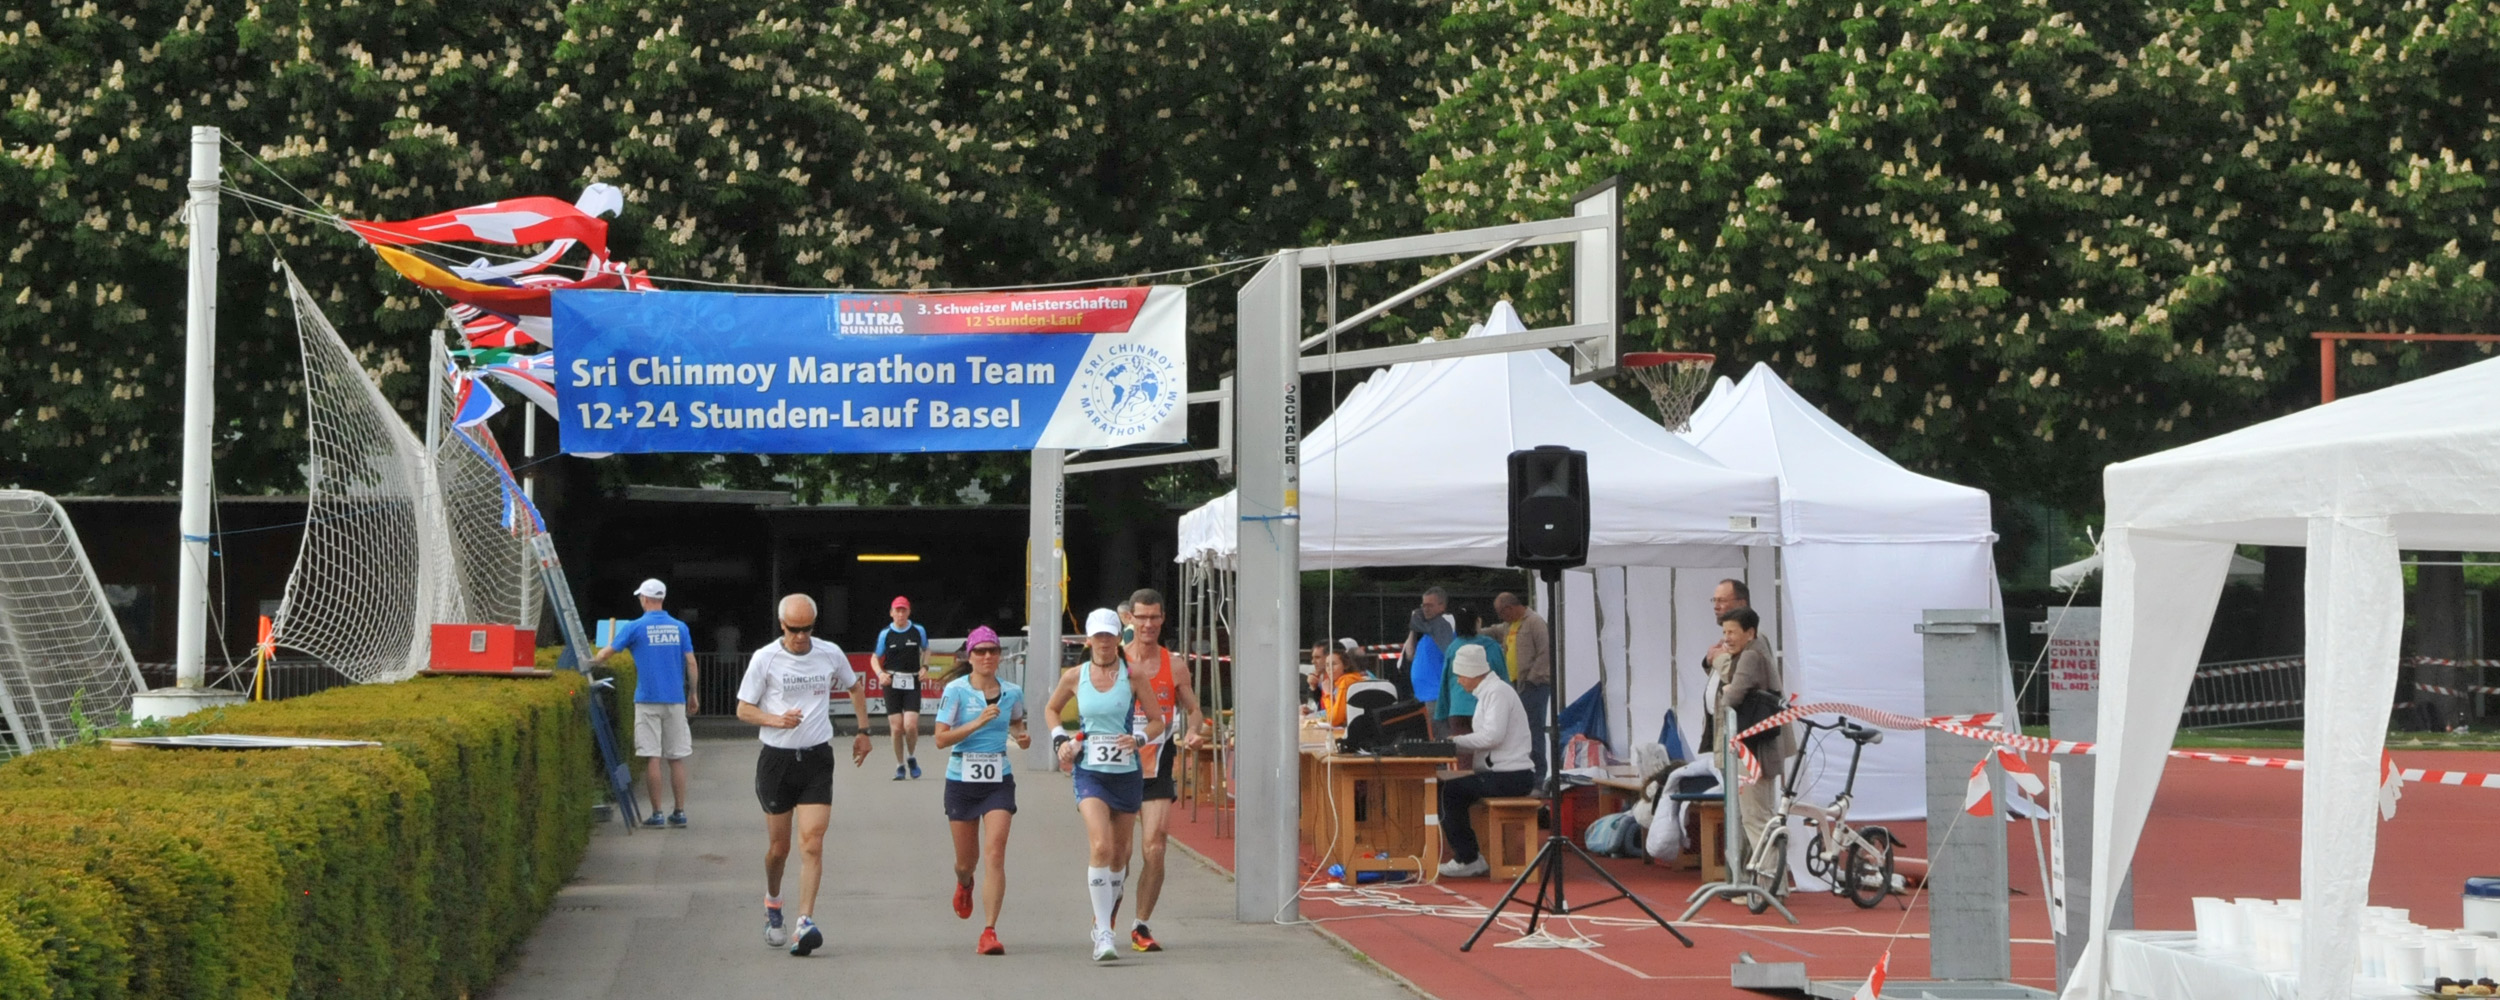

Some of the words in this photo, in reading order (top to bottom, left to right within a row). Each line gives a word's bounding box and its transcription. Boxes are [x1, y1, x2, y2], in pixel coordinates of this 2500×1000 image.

[917, 303, 931, 315] 3.
[934, 302, 1006, 315] Schweizer
[1011, 296, 1128, 311] Meisterschaften
[840, 313, 904, 325] ULTRA
[966, 316, 982, 327] 12
[987, 313, 1083, 326] Stunden-Lauf
[841, 326, 904, 334] RUNNING
[1085, 354, 1104, 376] SRI
[1109, 343, 1173, 371] CHINMOY
[571, 357, 617, 387] Sri
[628, 356, 776, 392] Chinmoy
[788, 354, 955, 384] Marathon
[966, 356, 1055, 384] Team
[577, 401, 679, 429] 12+24
[690, 398, 919, 428] Stunden-Lauf
[929, 399, 1020, 428] Basel
[1081, 397, 1146, 436] MARATHON
[1151, 391, 1177, 424] TEAM
[1284, 394, 1296, 465] SCHÄPER
[648, 633, 680, 644] TEAM
[2050, 648, 2099, 657] CONTAI
[2050, 658, 2099, 670] ZINGE
[783, 674, 826, 684] MÜNCHEN
[901, 679, 907, 688] 3
[783, 682, 826, 692] MARATHON
[1096, 746, 1122, 762] 32
[970, 763, 995, 779] 30
